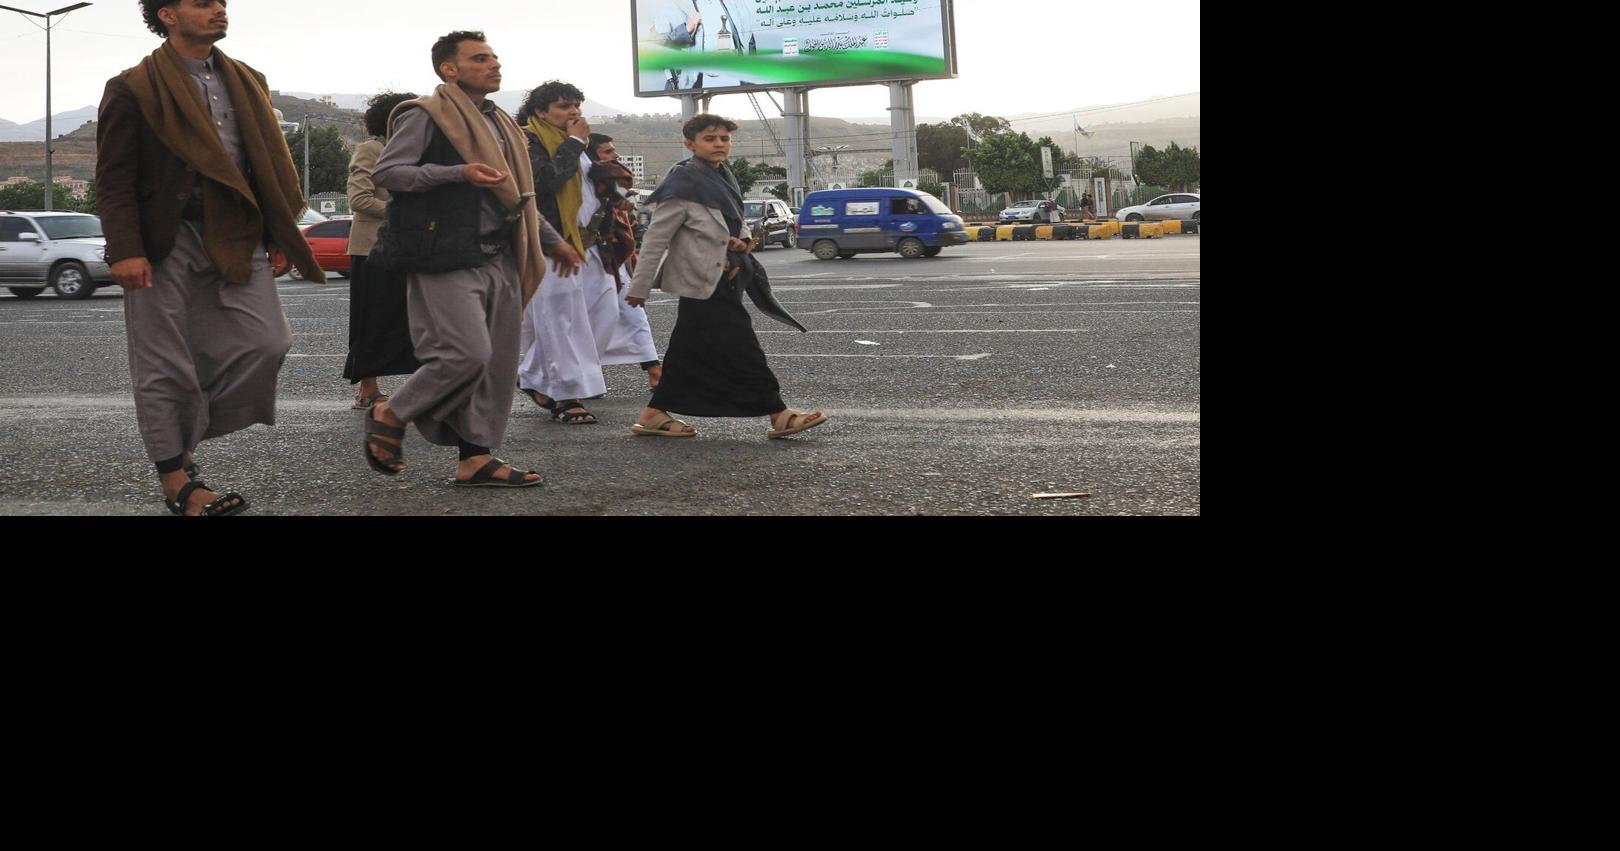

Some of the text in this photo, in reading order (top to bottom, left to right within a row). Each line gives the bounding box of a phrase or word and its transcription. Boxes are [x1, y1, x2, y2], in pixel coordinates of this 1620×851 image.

[756, 5, 774, 14] الله
[776, 5, 795, 15] عبد
[797, 4, 811, 13] بن
[814, 1, 844, 10] محمد
[824, 13, 859, 22] وسلامه
[860, 9, 879, 19] الله
[775, 18, 797, 28] وعلى
[798, 16, 822, 26] عليه
